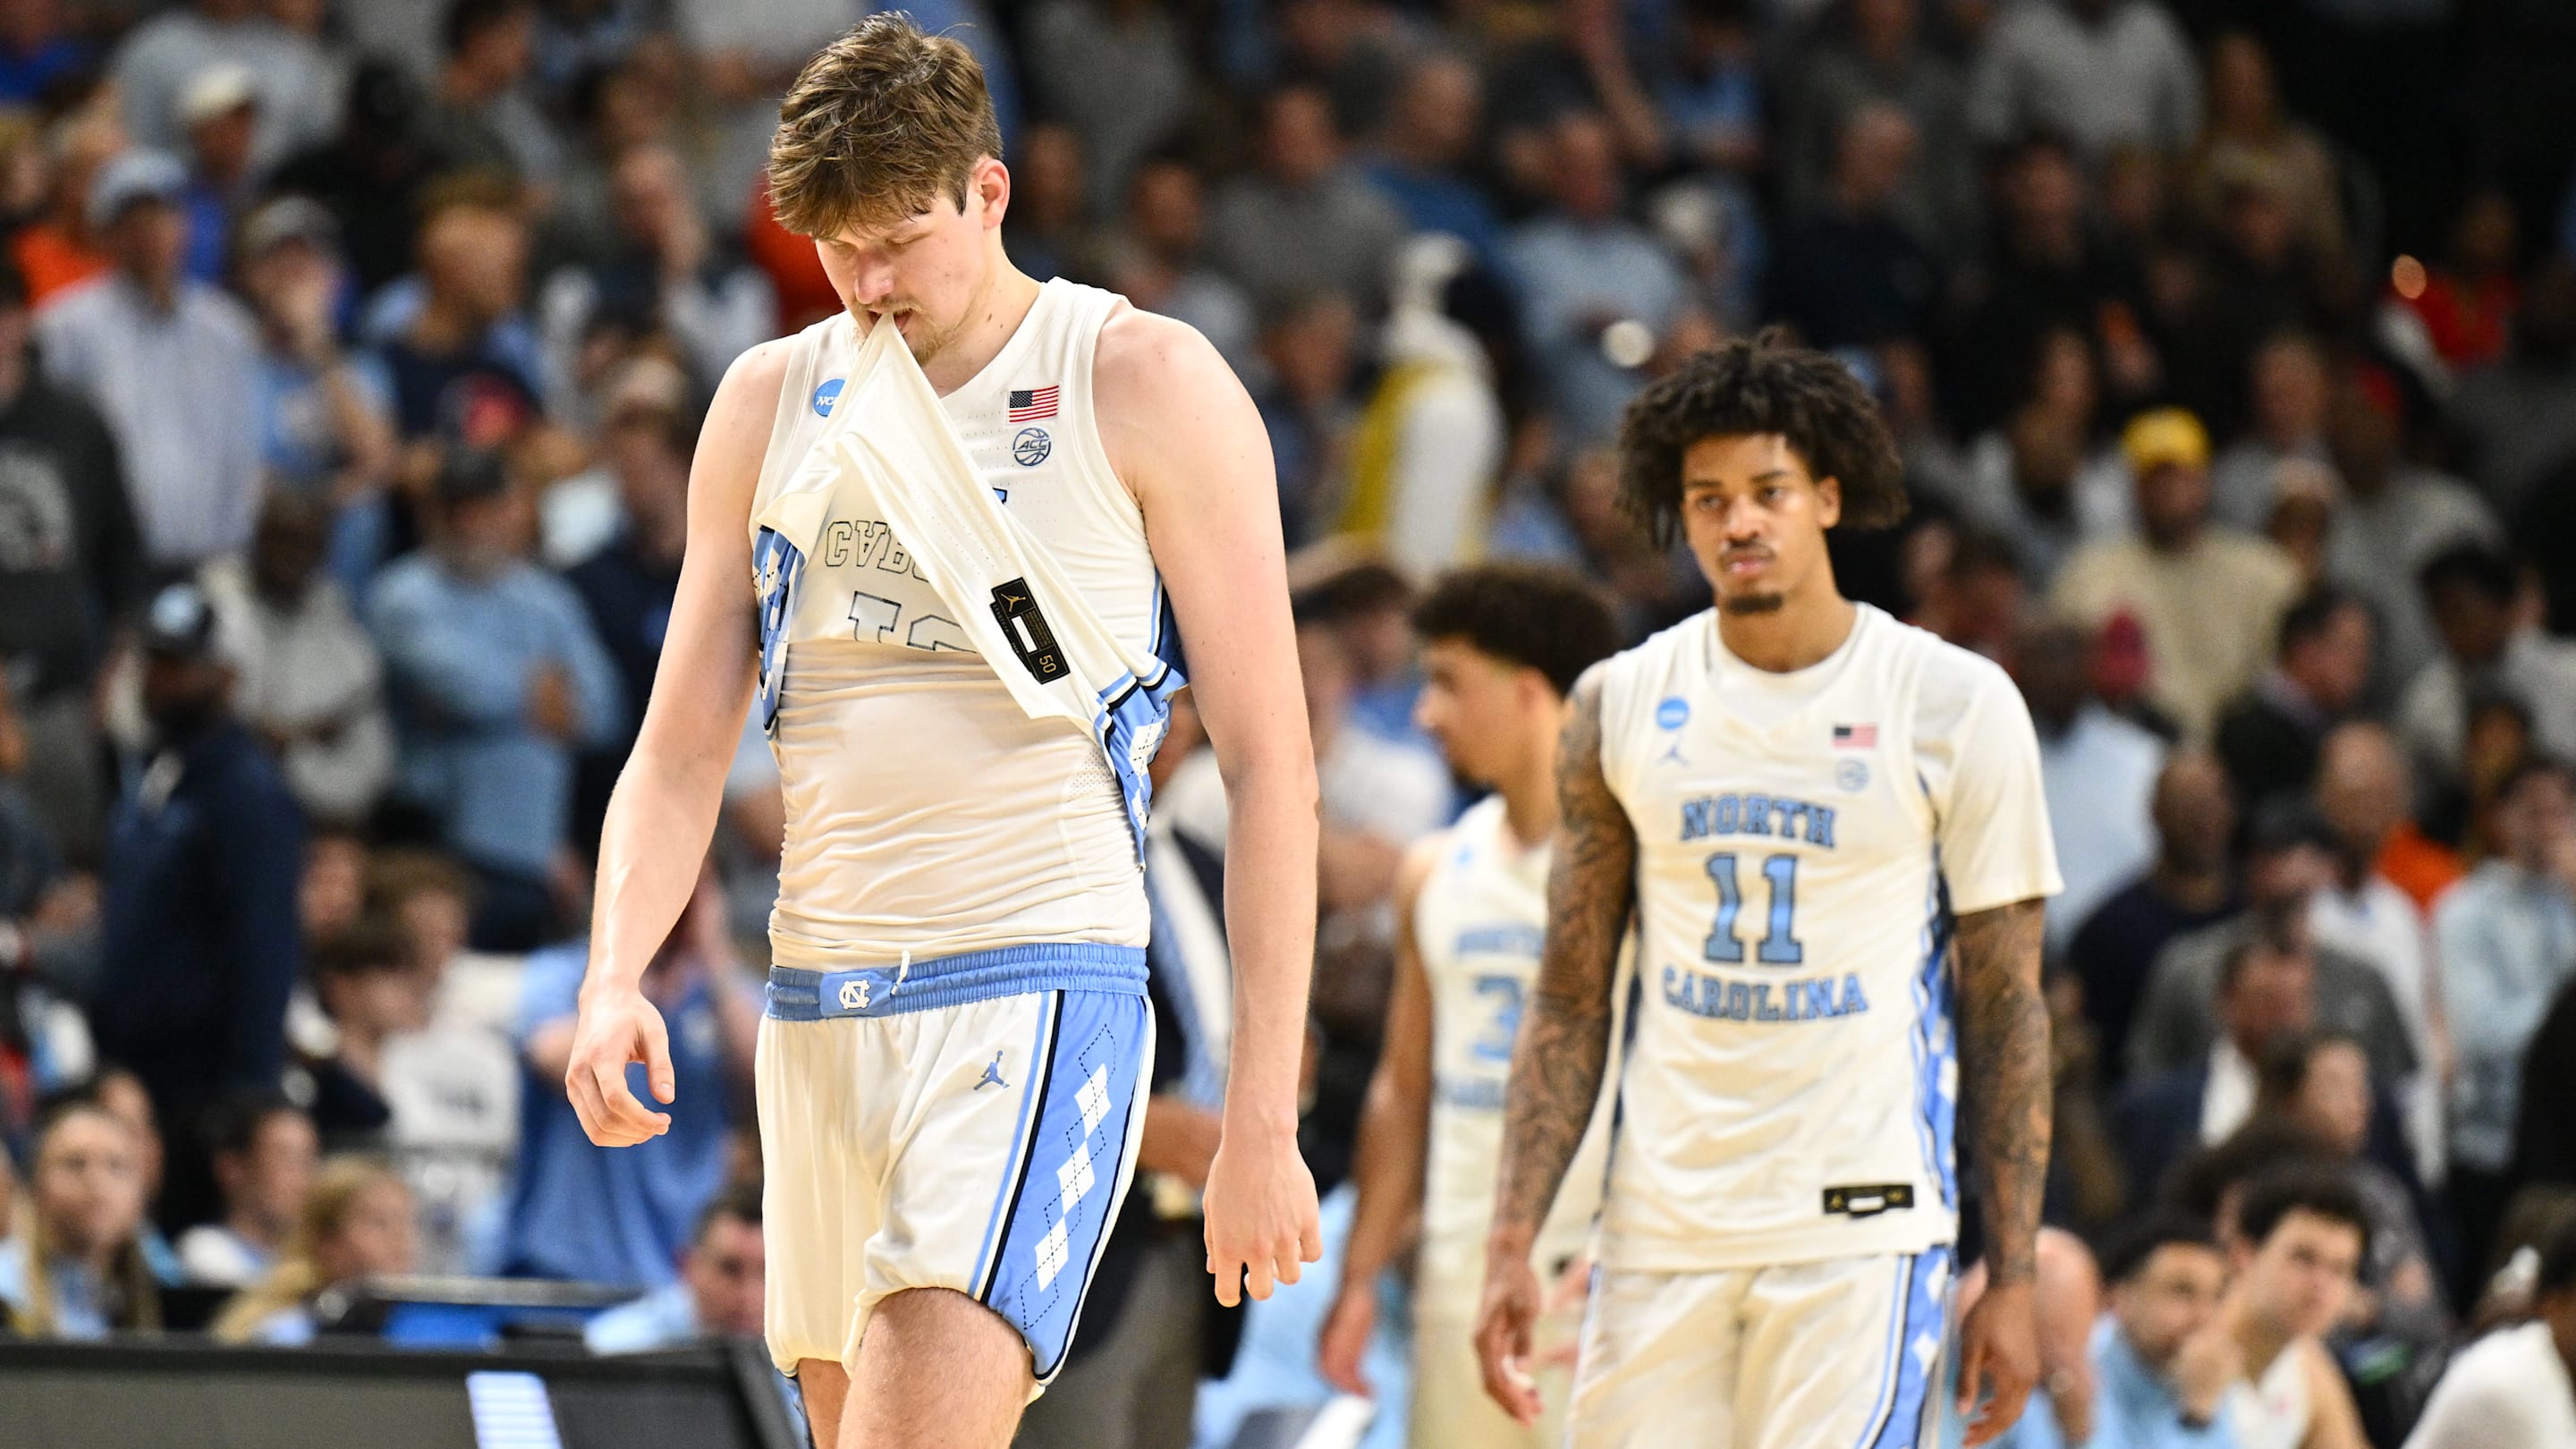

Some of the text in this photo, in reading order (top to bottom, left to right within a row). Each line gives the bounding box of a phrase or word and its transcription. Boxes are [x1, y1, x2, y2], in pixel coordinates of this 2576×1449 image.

[816, 396, 837, 406] NC
[1018, 437, 1048, 451] ACC
[1039, 654, 1056, 674] 50
[1679, 793, 1837, 850] NORTH
[1703, 852, 1804, 963] 11
[1469, 973, 1526, 1062] 3
[1662, 966, 1869, 1022] CAROLINA
